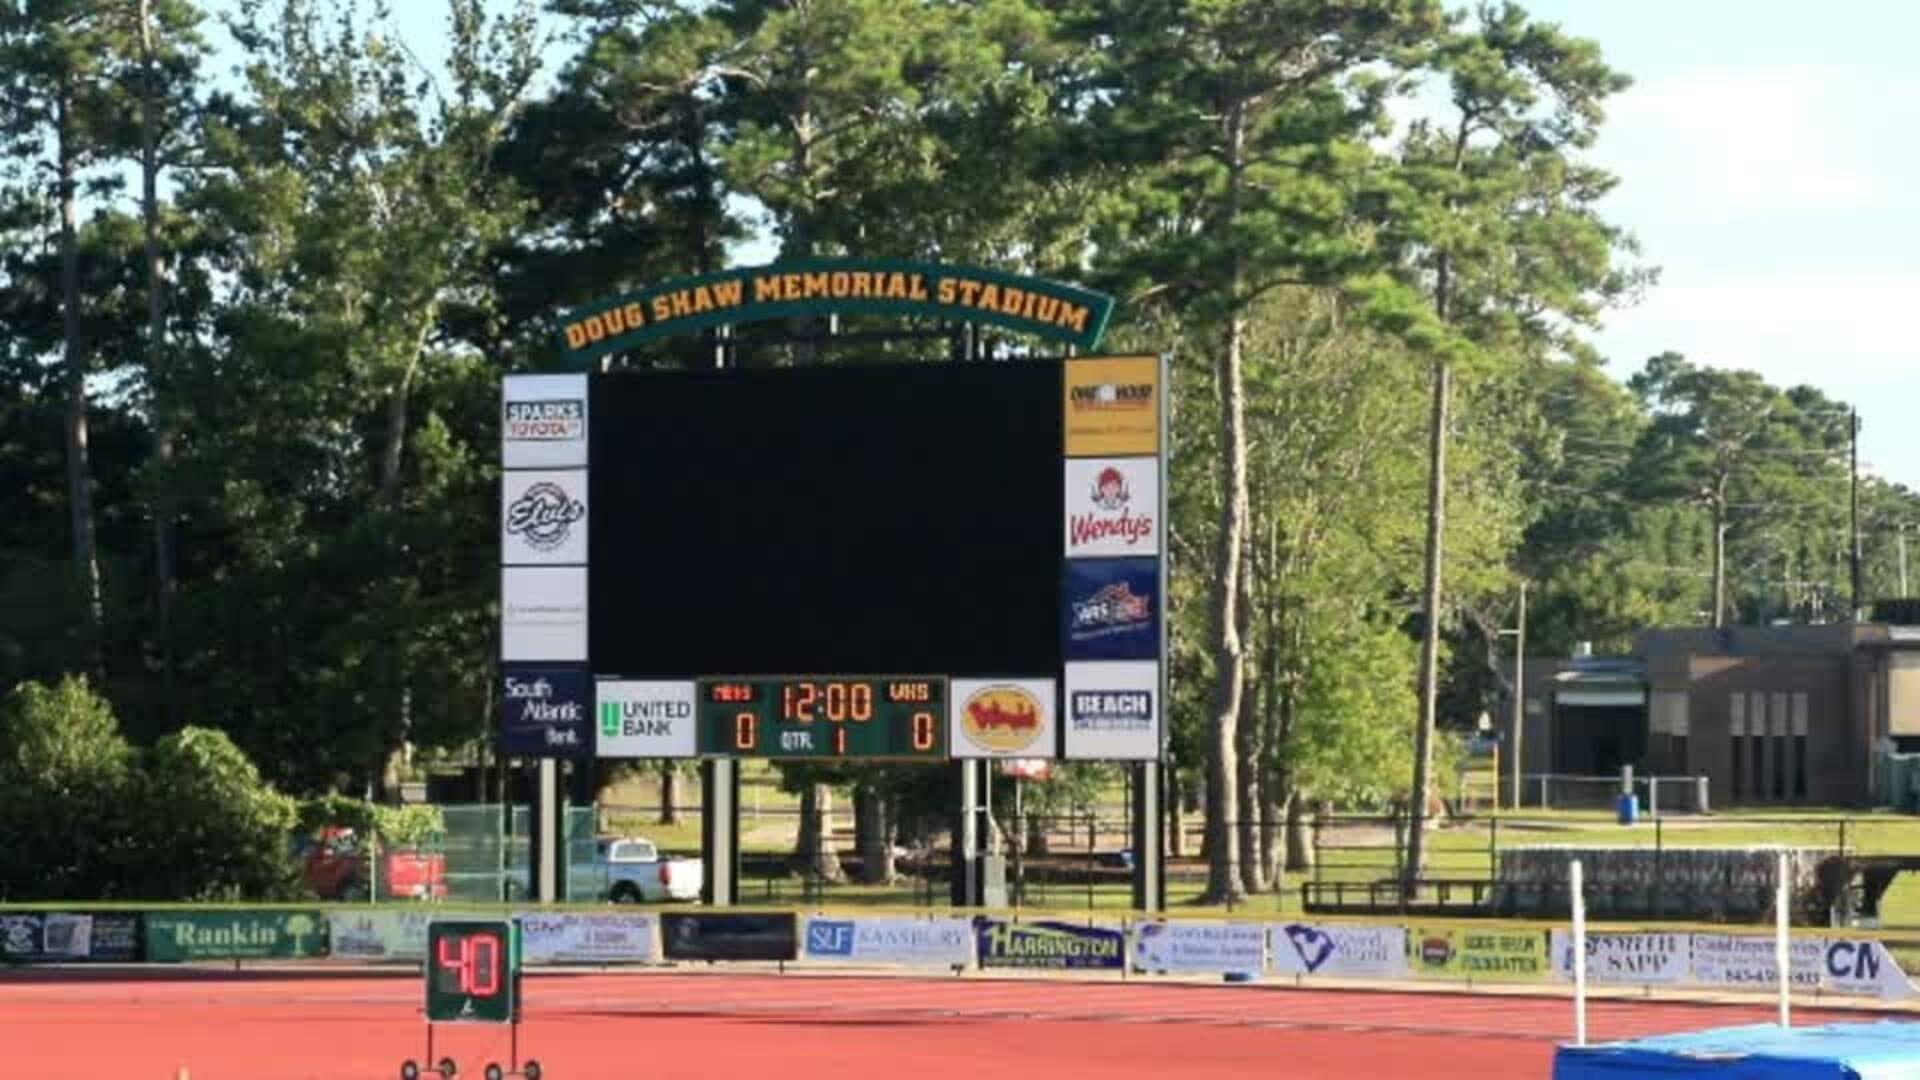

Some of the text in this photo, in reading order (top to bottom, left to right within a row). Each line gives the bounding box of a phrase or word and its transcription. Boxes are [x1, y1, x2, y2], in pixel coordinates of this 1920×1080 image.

[565, 272, 1089, 349] DOUG SHAW MEMORIAL STADIUM
[508, 403, 579, 420] SPARKS
[512, 421, 568, 435] TOYOTA
[1070, 507, 1153, 545] Wendy's
[505, 677, 552, 698] South
[520, 700, 583, 721] Atlantic
[623, 702, 691, 718] UNITED
[784, 683, 872, 721] 12:00
[1076, 695, 1148, 714] BEACH
[545, 727, 577, 745] Bank
[623, 720, 672, 736] BANK
[736, 712, 754, 749] 0
[837, 728, 845, 752] 1
[913, 712, 934, 750] 0
[175, 920, 276, 945] Rankin
[985, 922, 1119, 958] HARRINGTON
[437, 932, 499, 996] 40
